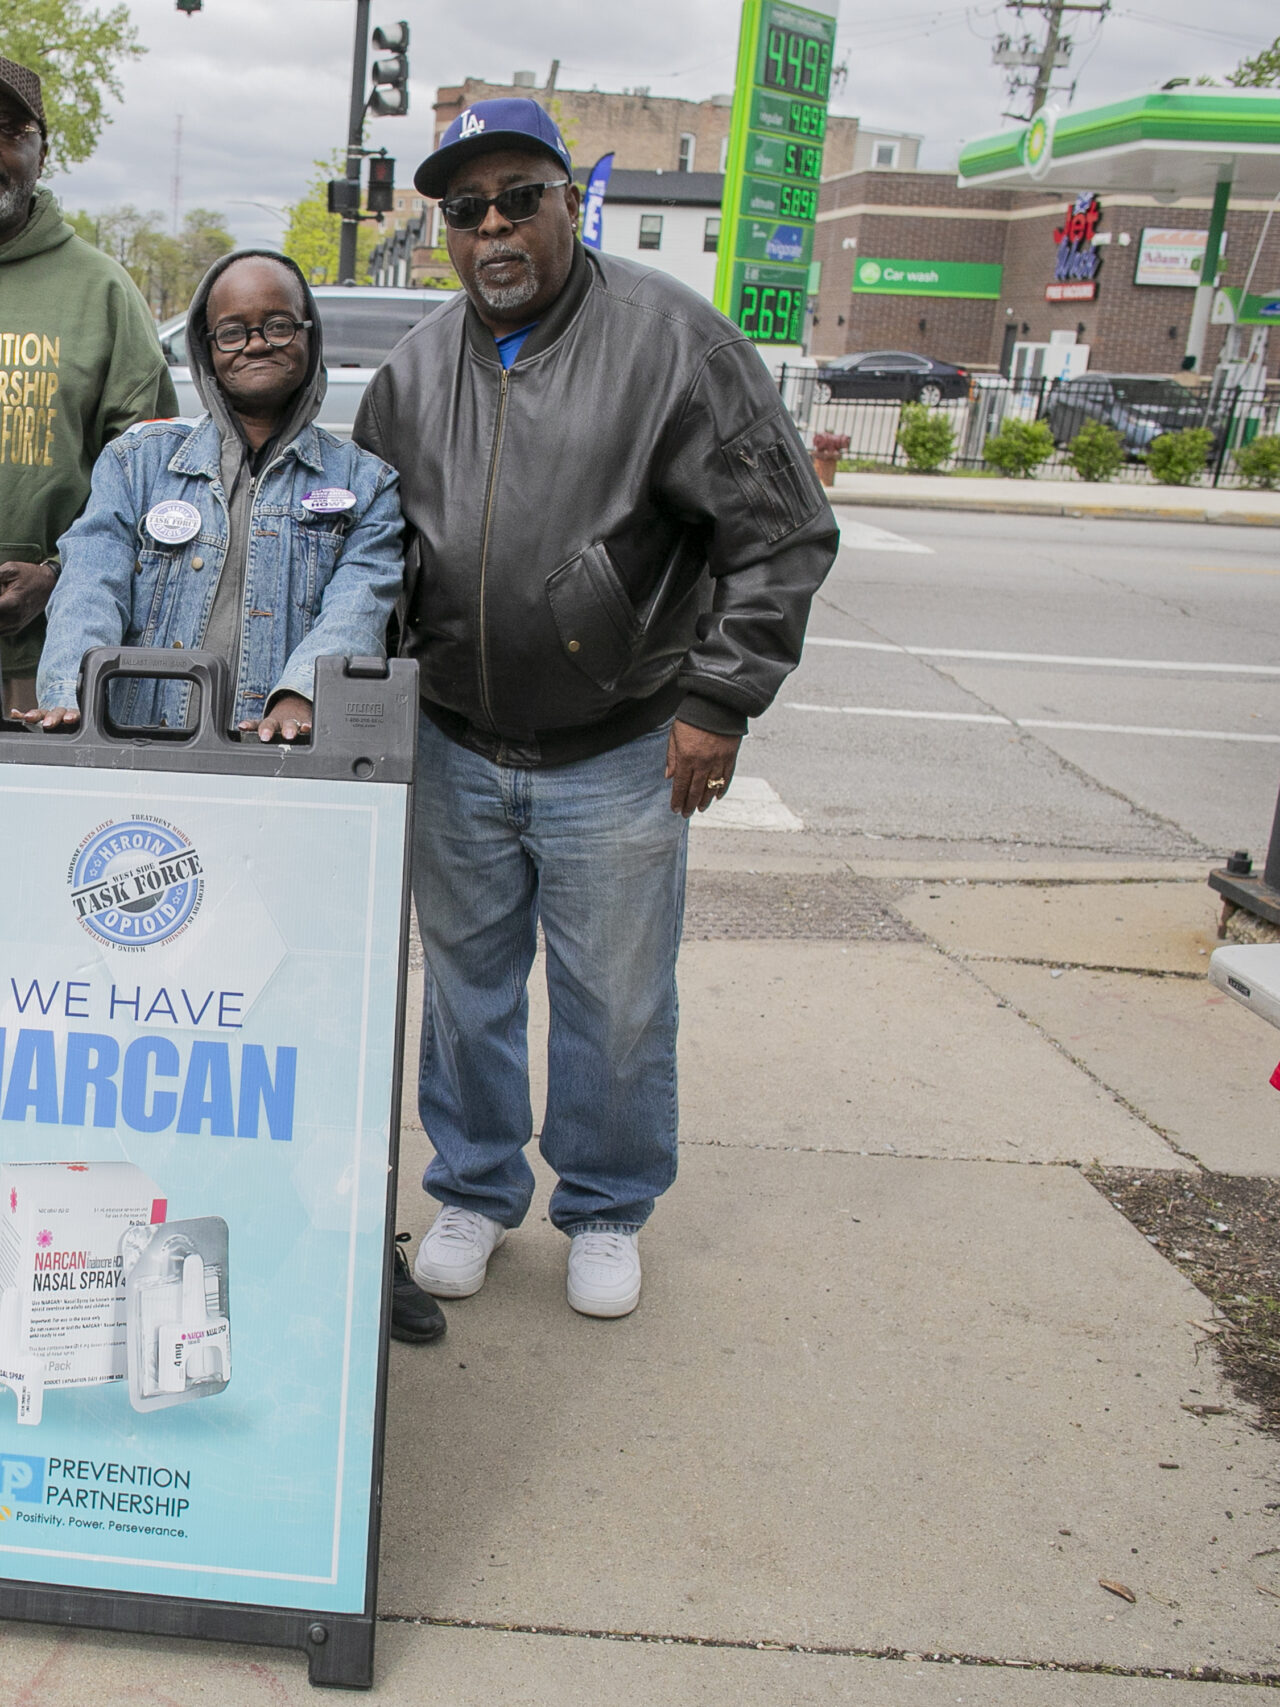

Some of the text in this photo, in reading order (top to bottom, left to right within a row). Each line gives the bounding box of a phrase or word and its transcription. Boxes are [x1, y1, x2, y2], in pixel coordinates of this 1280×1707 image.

[459, 109, 486, 139] LA
[1053, 200, 1099, 244] Jet
[883, 267, 939, 283] Car wash
[740, 286, 791, 340] 2.69
[0, 405, 58, 467] FORCE
[79, 831, 95, 849] SAVES
[95, 818, 114, 834] LIVES
[131, 813, 193, 847] TREATMENT WORKS
[72, 854, 204, 918] TASK FORCE
[112, 862, 156, 883] WEST SIDE
[103, 902, 178, 936] OPIOID
[10, 976, 245, 1029] WE HAVE
[33, 1272, 77, 1292] NASAL
[79, 1270, 122, 1290] SPRAY
[48, 1360, 72, 1371] Pack
[175, 1343, 184, 1359] mg
[48, 1457, 191, 1490] PREVENTION
[46, 1485, 190, 1518] PARTNERSHIP
[16, 1511, 189, 1539] Positivity. Power. Perseverance.
